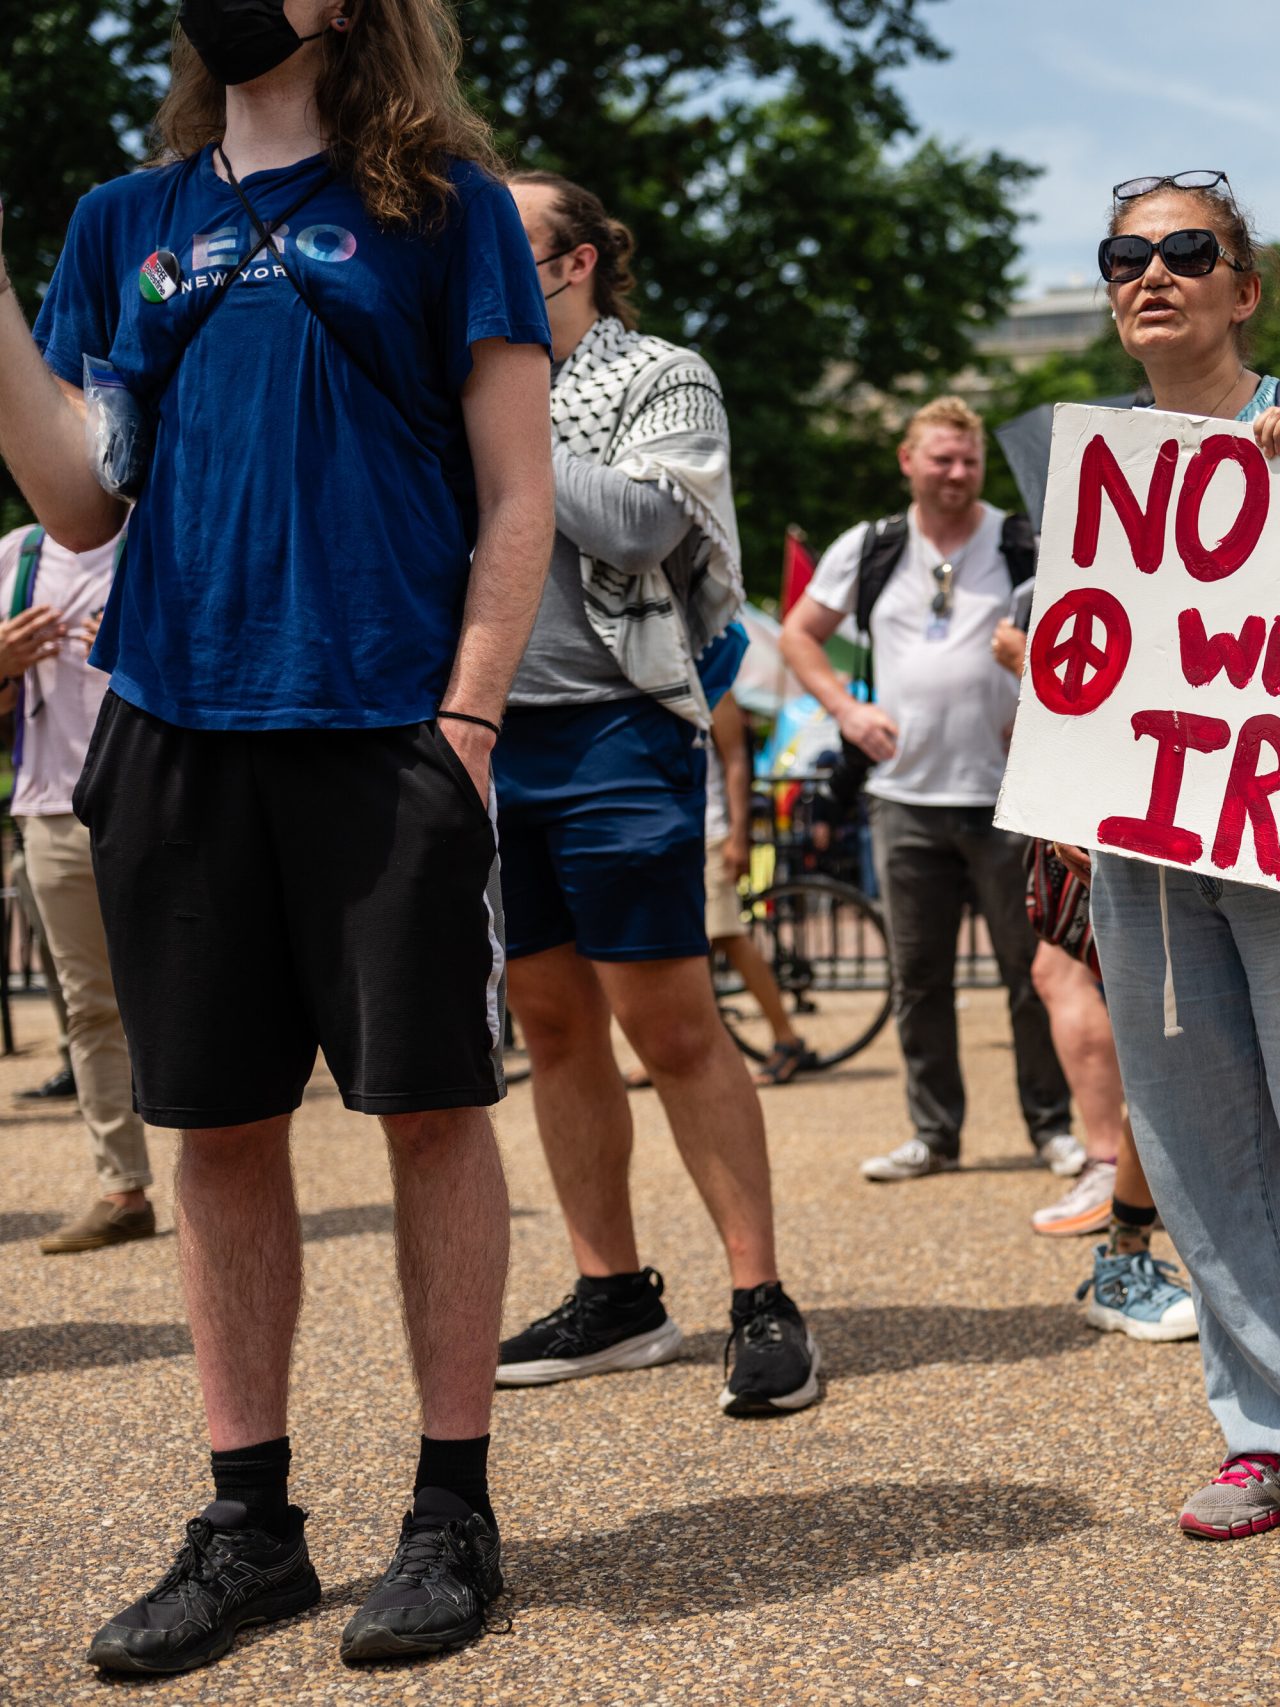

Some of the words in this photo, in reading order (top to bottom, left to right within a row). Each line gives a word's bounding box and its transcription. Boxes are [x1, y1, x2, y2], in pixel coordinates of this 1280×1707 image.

[144, 263, 166, 296] Palestine
[154, 262, 168, 283] FREE
[181, 271, 229, 294] NEW
[239, 265, 288, 282] YOR
[1072, 434, 1270, 583] NO
